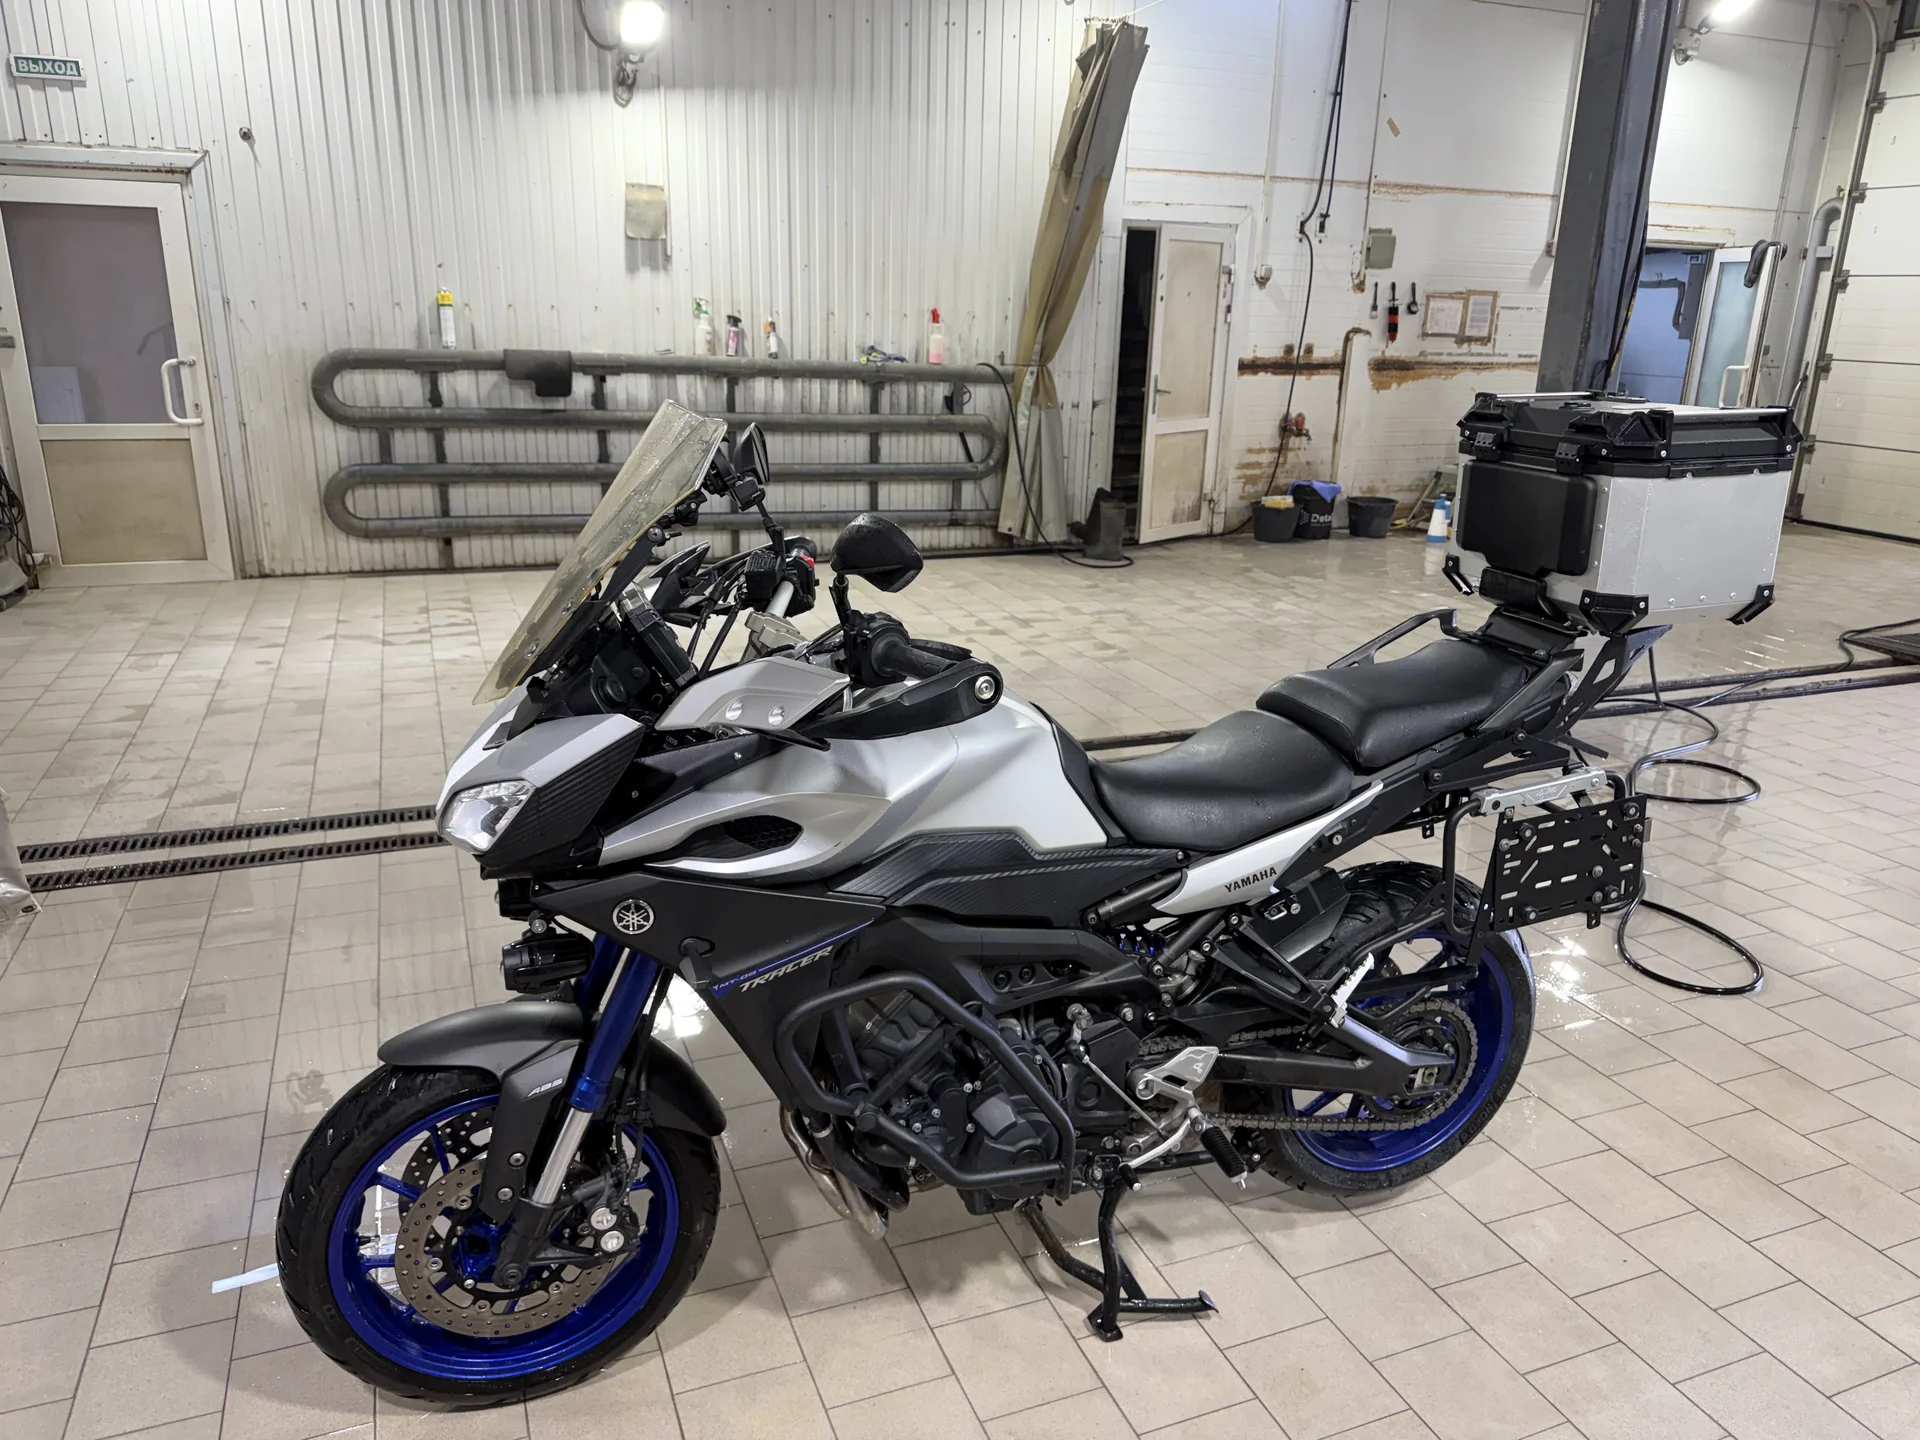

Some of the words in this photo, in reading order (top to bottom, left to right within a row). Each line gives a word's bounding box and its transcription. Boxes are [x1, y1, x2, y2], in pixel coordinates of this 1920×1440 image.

[17, 59, 79, 76] ВЫХОД
[1224, 866, 1278, 893] YAMAHA
[739, 945, 834, 993] TRACER
[527, 1077, 564, 1098] ABS
